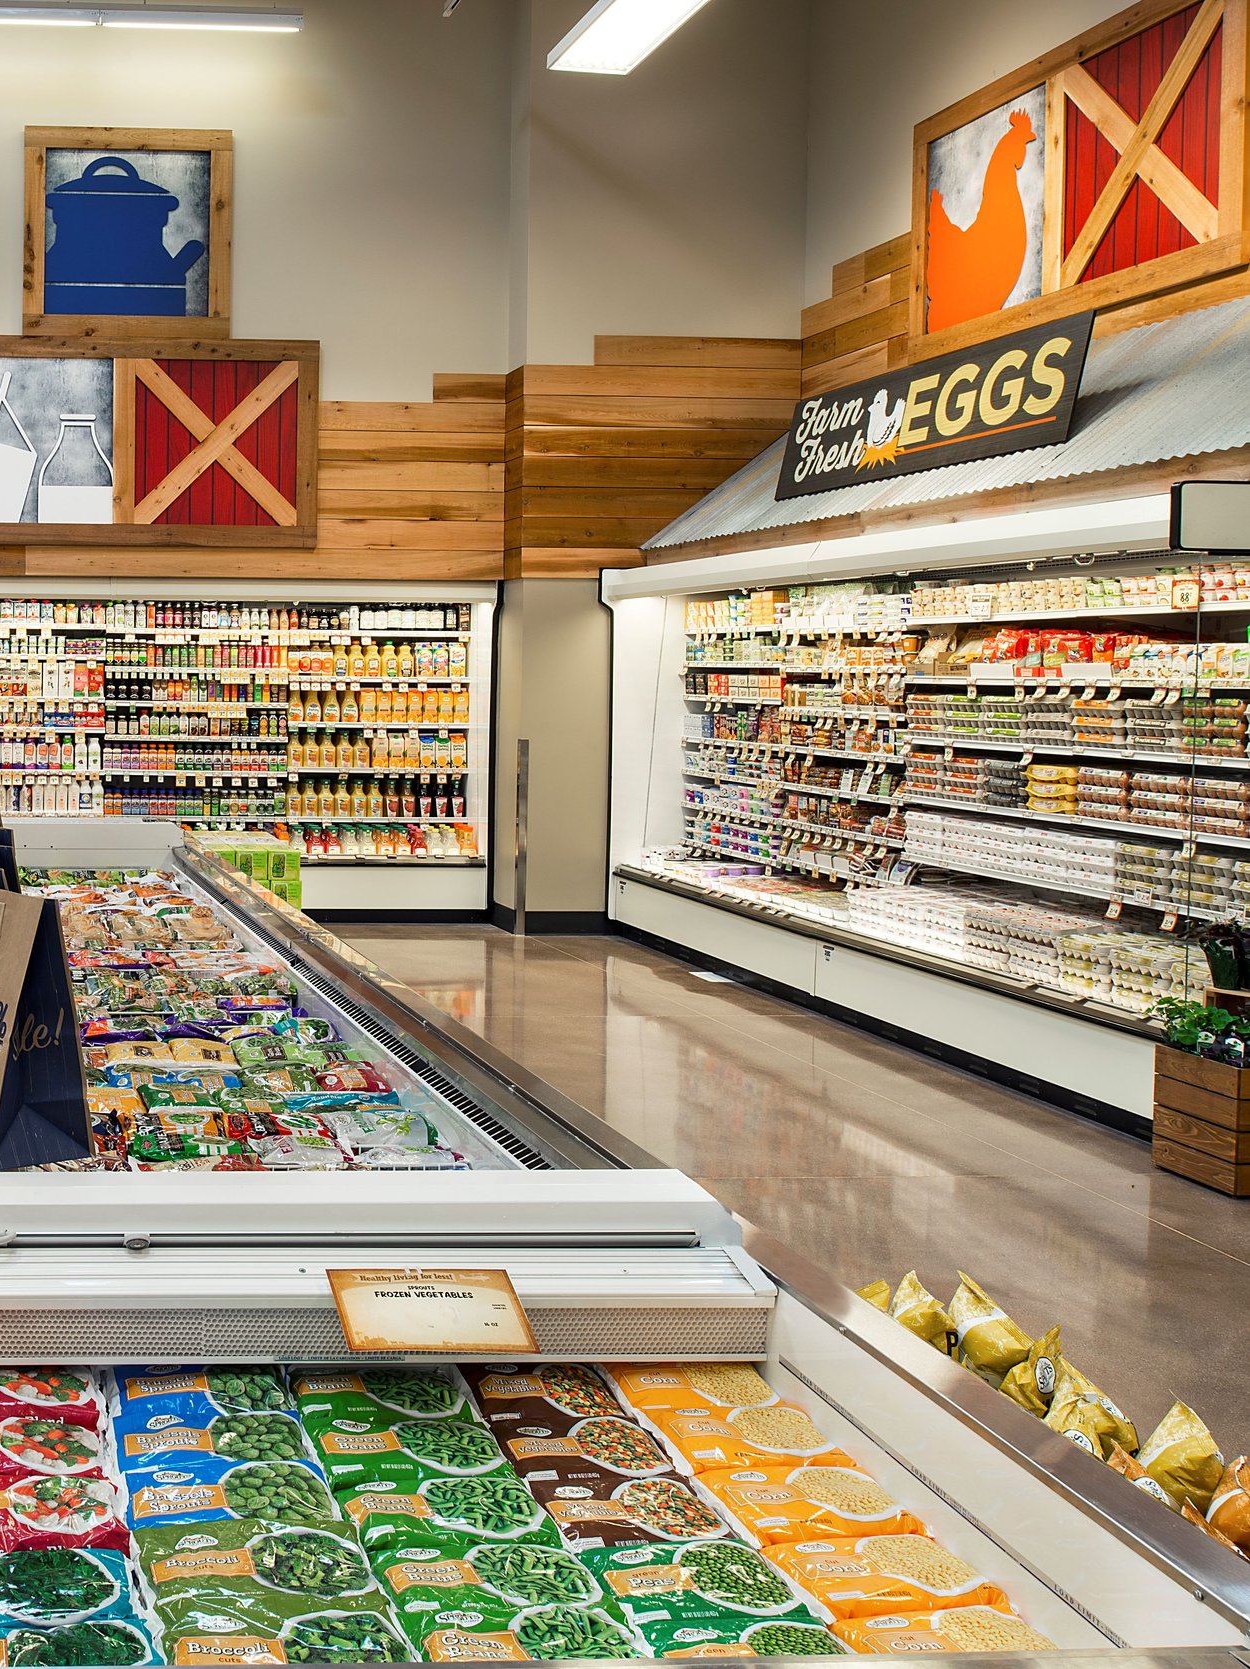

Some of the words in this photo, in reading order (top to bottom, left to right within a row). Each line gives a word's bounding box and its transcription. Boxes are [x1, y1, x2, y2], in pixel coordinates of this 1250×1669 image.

[897, 337, 1072, 447] EGGS
[795, 396, 866, 444] Farm
[793, 429, 867, 483] Fresh
[359, 1274, 392, 1283] Healthy
[393, 1273, 419, 1282] living
[434, 1273, 454, 1281] less!
[374, 1290, 413, 1299] FROZEN
[414, 1290, 474, 1299] VEGETABLES
[135, 1374, 196, 1386] Brussels
[141, 1380, 194, 1393] Sprouts
[308, 1381, 353, 1390] Beans
[493, 1377, 528, 1386] Mixed
[640, 1375, 679, 1385] Corn
[483, 1384, 542, 1396] Vegetables
[688, 1422, 730, 1436] Corn
[136, 1430, 200, 1445] Brussels
[141, 1437, 198, 1451] Sprouts
[334, 1435, 384, 1443] Green
[524, 1439, 563, 1448] Mixed
[337, 1441, 387, 1450] Beans
[143, 1489, 215, 1502] Brussels
[748, 1489, 791, 1502] Corn
[928, 1479, 950, 1501] LIMIT
[150, 1496, 212, 1512] Sprouts
[165, 1555, 240, 1568] Broccoli
[816, 1561, 863, 1574] Corn
[401, 1562, 458, 1575] Green
[632, 1570, 660, 1579] green
[407, 1572, 463, 1583] Beans
[629, 1575, 676, 1588] Peas
[1053, 1583, 1075, 1605] LOAD
[1075, 1602, 1103, 1629] LIMIT
[441, 1633, 506, 1648] Green
[890, 1638, 944, 1651] Corn
[187, 1642, 270, 1656] Broccoli
[448, 1646, 509, 1659] Beans
[218, 1656, 241, 1664] cuts
